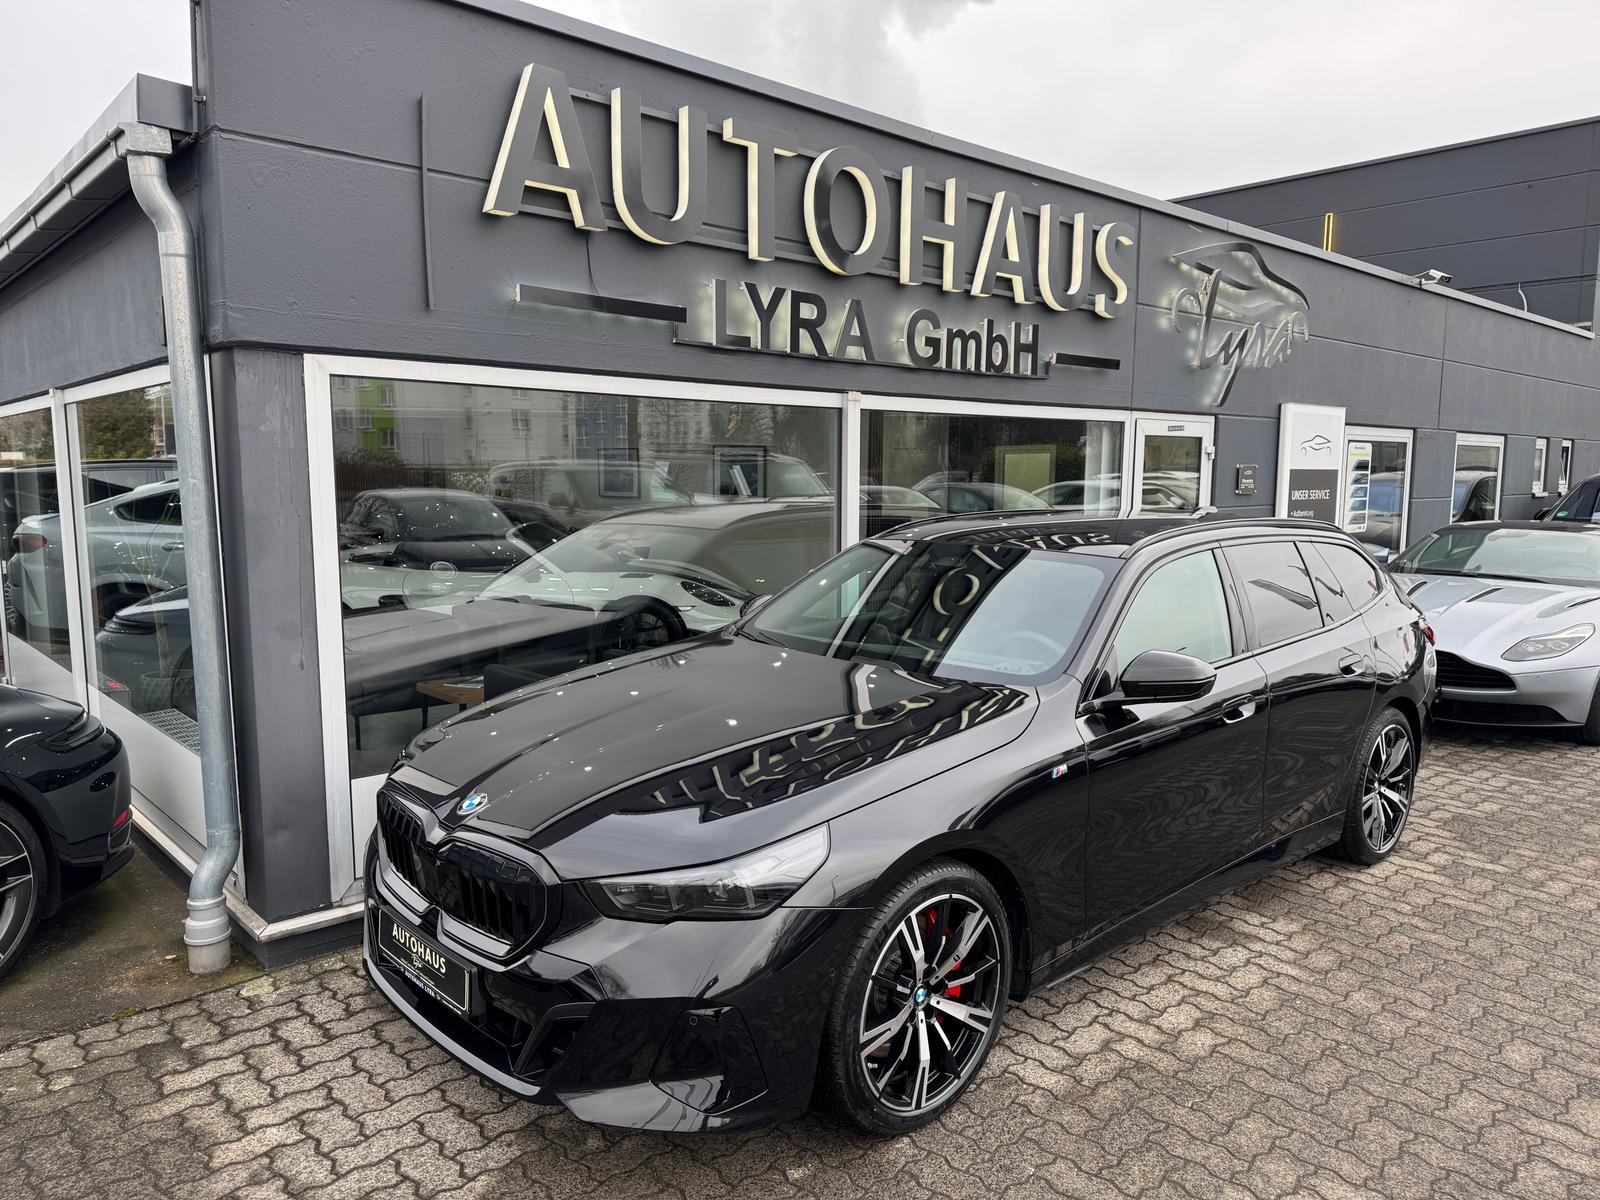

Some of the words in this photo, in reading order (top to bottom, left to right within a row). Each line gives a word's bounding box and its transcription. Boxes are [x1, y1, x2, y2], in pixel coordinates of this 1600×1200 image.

[482, 62, 1135, 319] AUTOHAUS
[712, 278, 876, 361] LYRA
[904, 307, 1040, 376] GmbH
[1292, 489, 1309, 500] UNSER
[1309, 489, 1330, 500] SERVICE
[392, 922, 446, 974] AUTOHAUS
